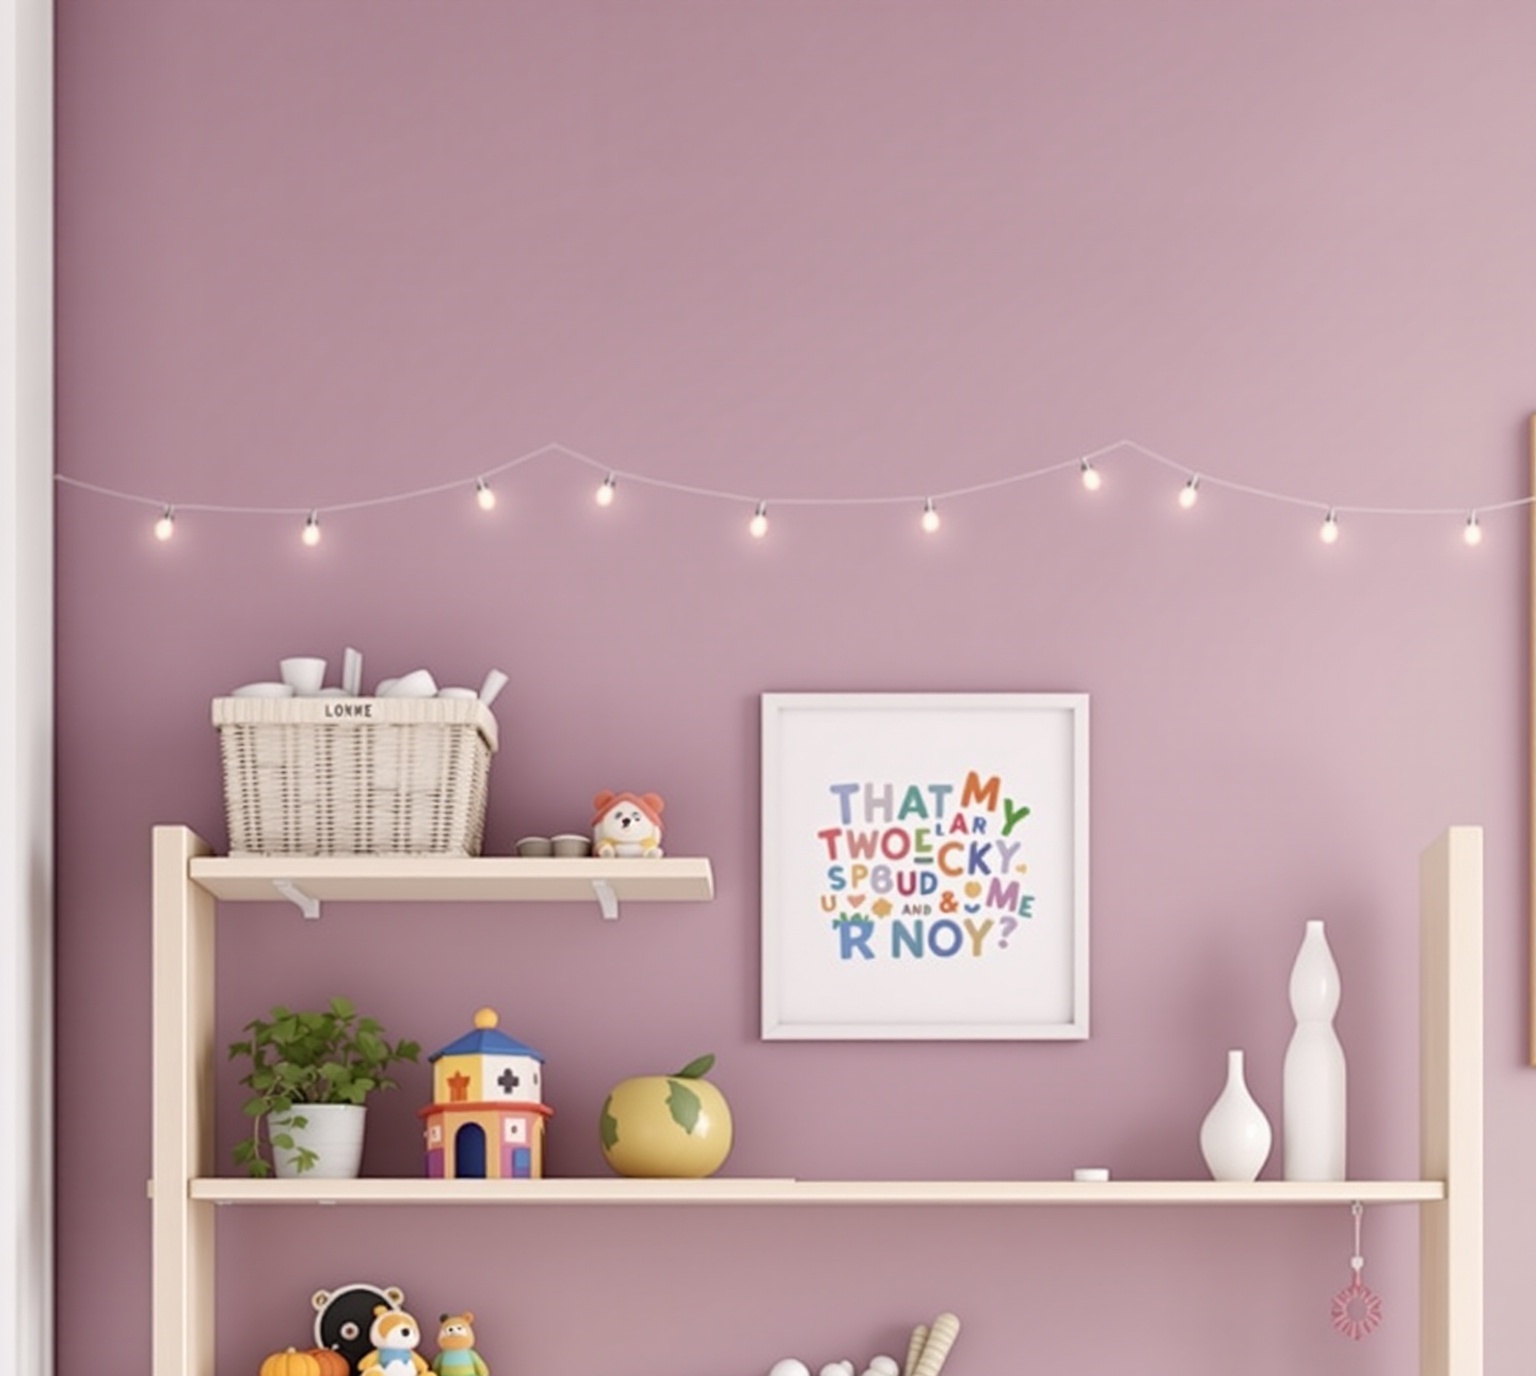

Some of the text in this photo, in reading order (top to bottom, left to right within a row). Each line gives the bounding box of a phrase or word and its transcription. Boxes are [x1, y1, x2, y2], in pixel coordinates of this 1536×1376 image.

[829, 770, 1031, 837] THAT MY
[902, 903, 932, 916] AND
[939, 890, 959, 914] &
[985, 877, 1036, 920] ME
